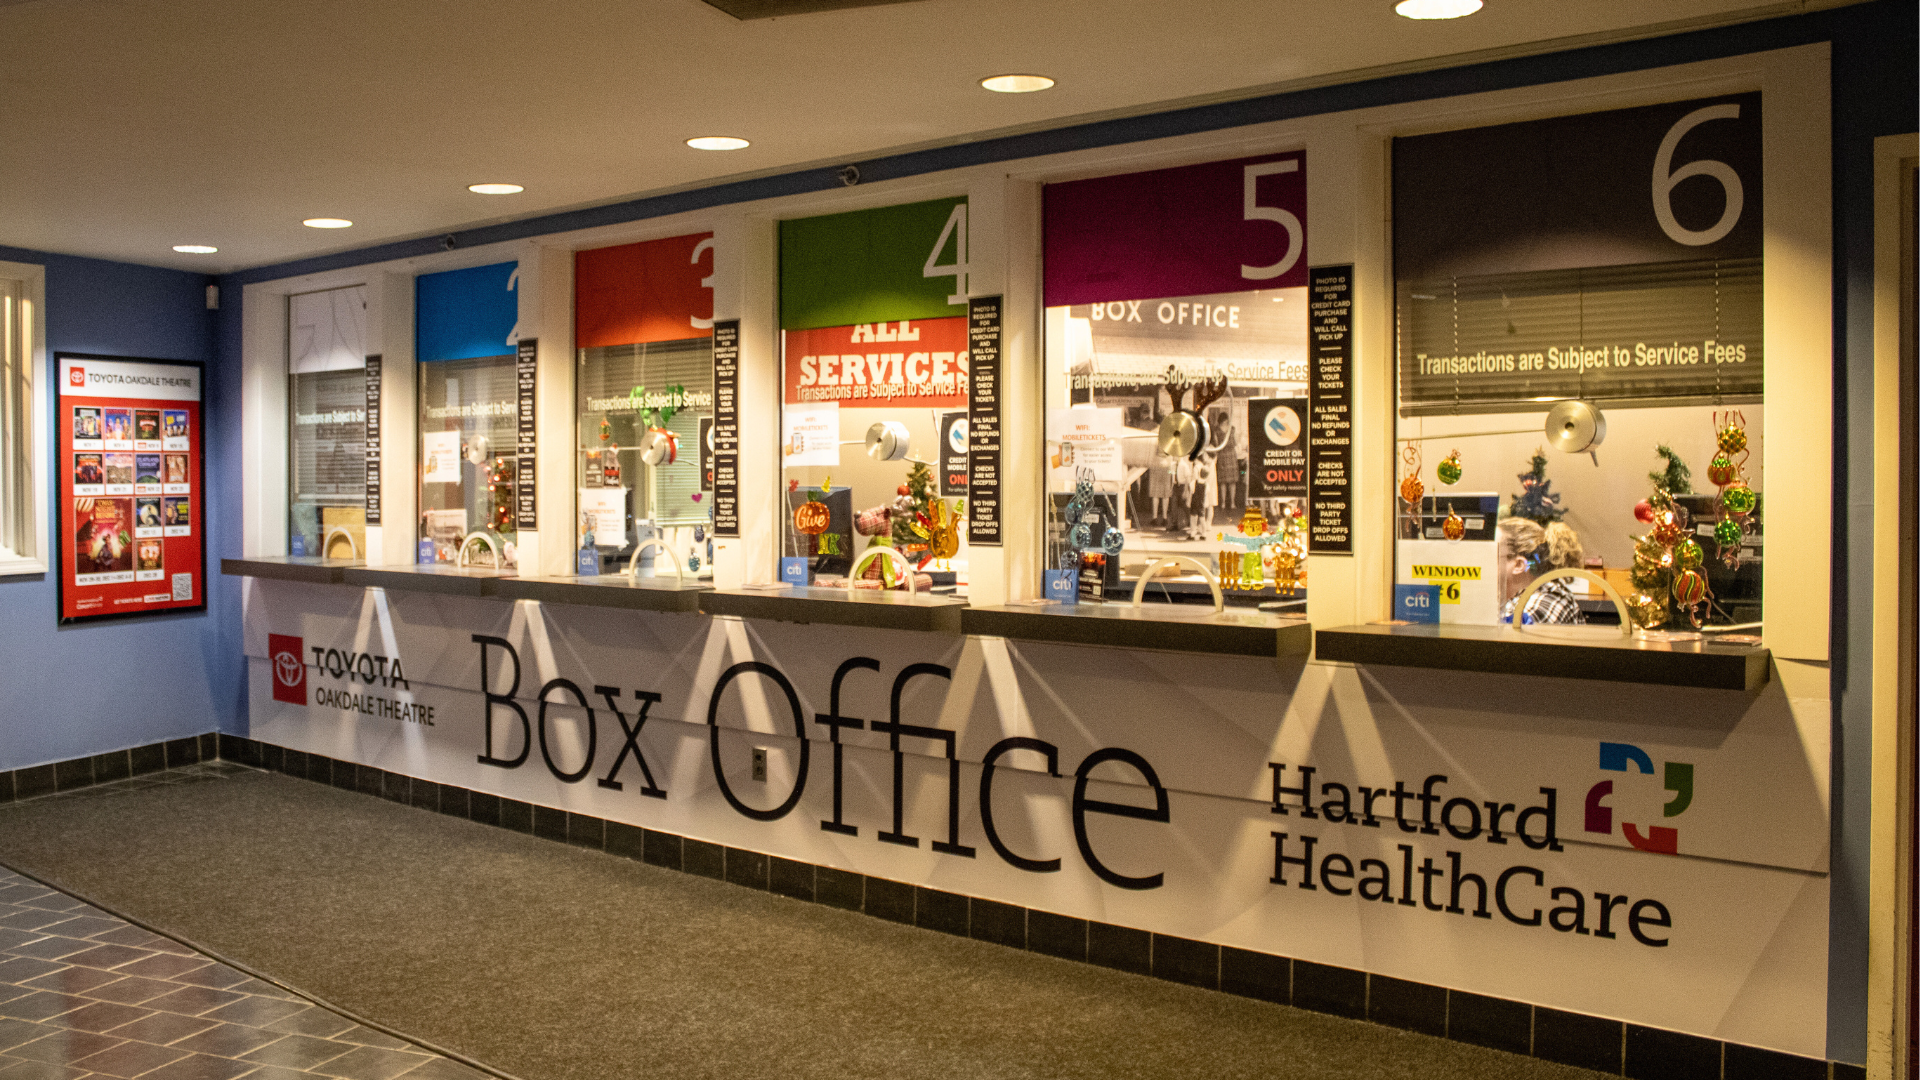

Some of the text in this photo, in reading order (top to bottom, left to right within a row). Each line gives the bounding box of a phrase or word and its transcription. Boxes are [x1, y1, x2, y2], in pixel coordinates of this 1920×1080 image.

[1651, 103, 1744, 246] 6
[1241, 158, 1304, 280] 5
[923, 203, 968, 304] 4
[1091, 300, 1240, 329] BOX OFFICE
[851, 321, 920, 343] ALL
[1319, 357, 1343, 365] PLEASE
[1417, 341, 1746, 374] Transactions are Subject to Service Fees
[800, 351, 969, 386] SERVICES
[1227, 362, 1274, 379] Service
[1278, 361, 1308, 380] Fees
[89, 373, 191, 388] TOYOTA OAKDALE THEATRE
[796, 385, 851, 400] Transactions
[854, 384, 868, 398] are
[870, 381, 905, 401] Subject
[907, 382, 916, 396] to
[919, 380, 954, 396] Service
[1319, 381, 1344, 389] TICKETS
[587, 396, 630, 411] Transactions
[645, 392, 672, 411] Subject
[683, 391, 711, 406] Service
[1322, 421, 1350, 429] REFUNDS
[1263, 458, 1290, 466] MOBILE
[1266, 470, 1304, 482] ONLY
[795, 506, 826, 530] Give
[787, 564, 801, 575] citi
[1414, 565, 1481, 578] WINDOW
[1053, 579, 1072, 590] citi
[1405, 594, 1430, 608] citi
[311, 646, 409, 691] TOYOTA
[315, 687, 435, 727] OAKDALE THEATRE
[471, 634, 1170, 890] Box Office
[1268, 762, 1564, 852] Hartford
[1269, 831, 1672, 948] HealthCare
